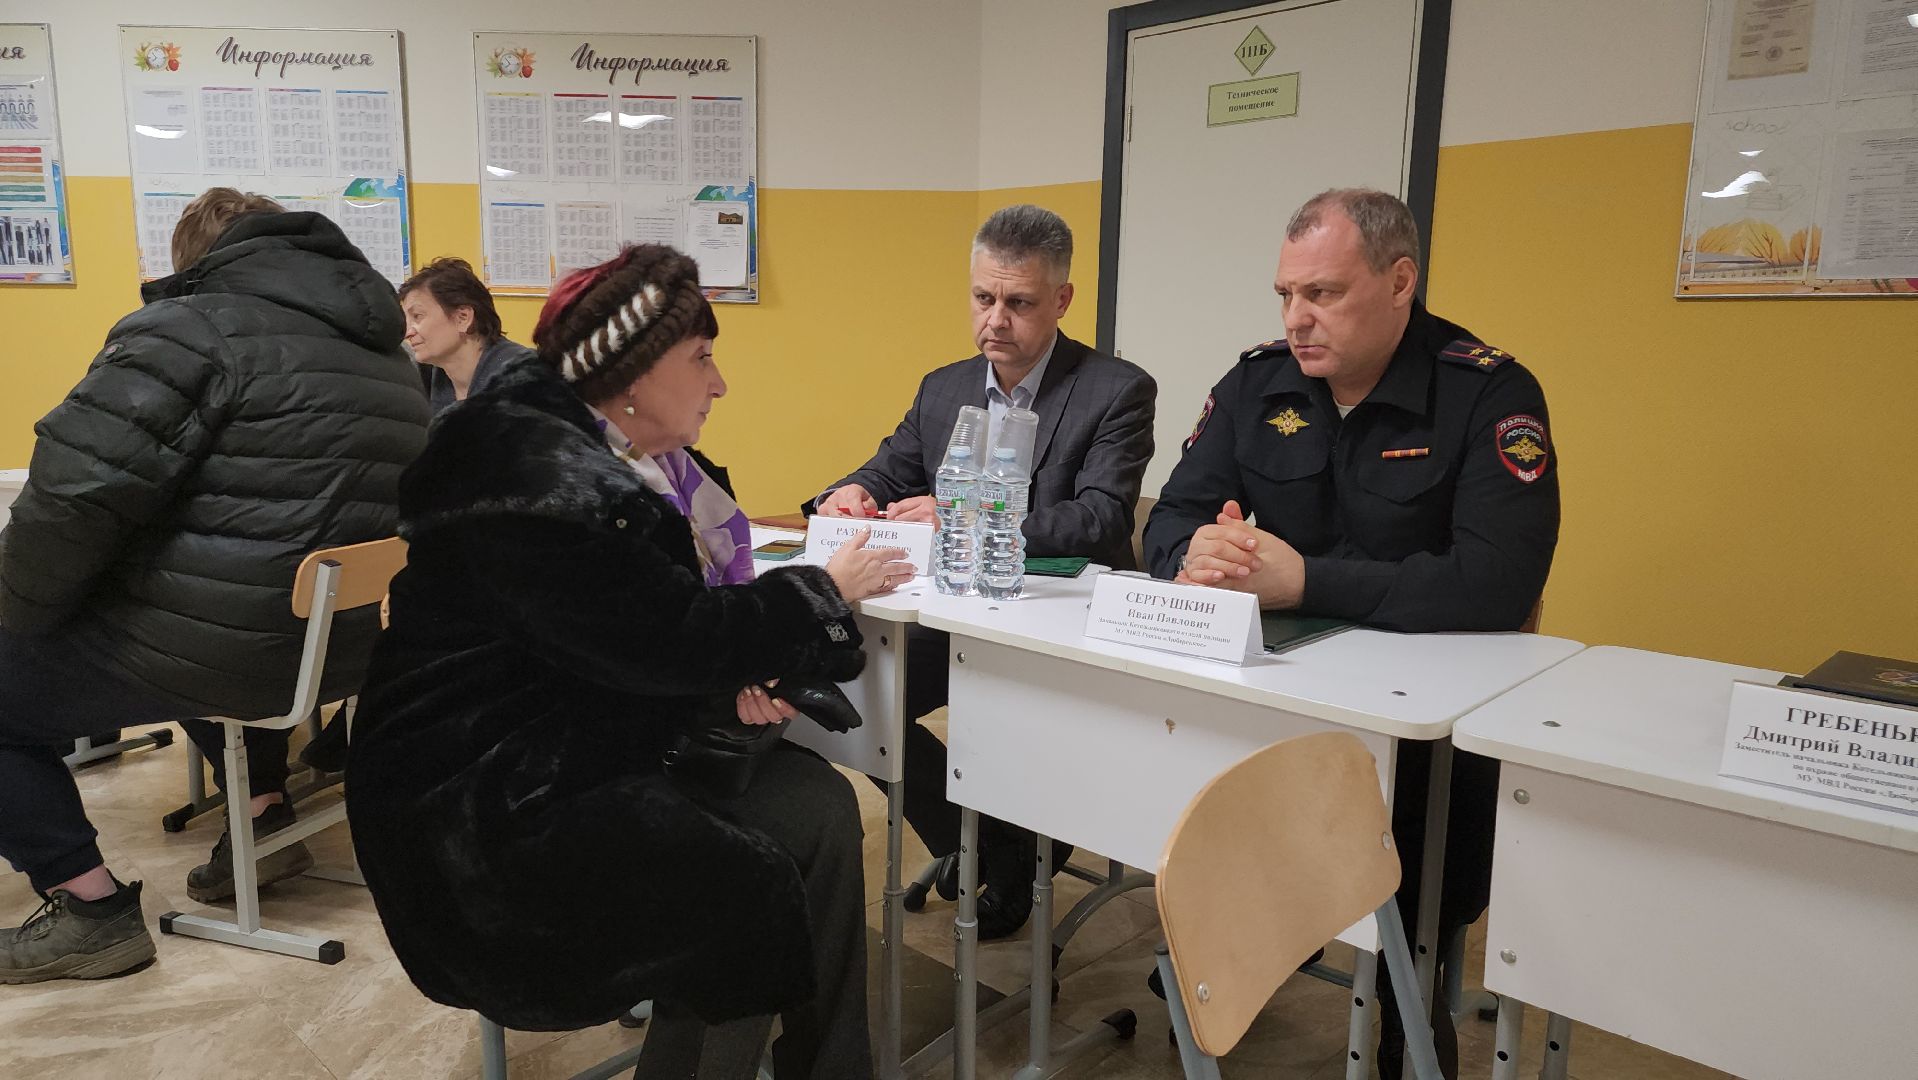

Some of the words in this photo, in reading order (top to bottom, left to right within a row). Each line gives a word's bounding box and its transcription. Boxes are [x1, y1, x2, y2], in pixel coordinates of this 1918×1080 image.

[215, 36, 375, 79] Информация
[1240, 43, 1269, 59] 111Б
[570, 42, 731, 85] Информация
[1226, 86, 1279, 100] Техническое
[1228, 100, 1275, 113] помещение
[1506, 427, 1542, 442] РОССИЯ
[1518, 468, 1538, 482] МВД
[1125, 591, 1217, 615] СЕРГУШКИН
[1127, 608, 1155, 621] Иван
[1156, 612, 1211, 630] Павлович
[1735, 741, 1791, 758] Заместитель
[1743, 725, 1840, 754] Дмитрий
[1845, 742, 1918, 768] Влади
